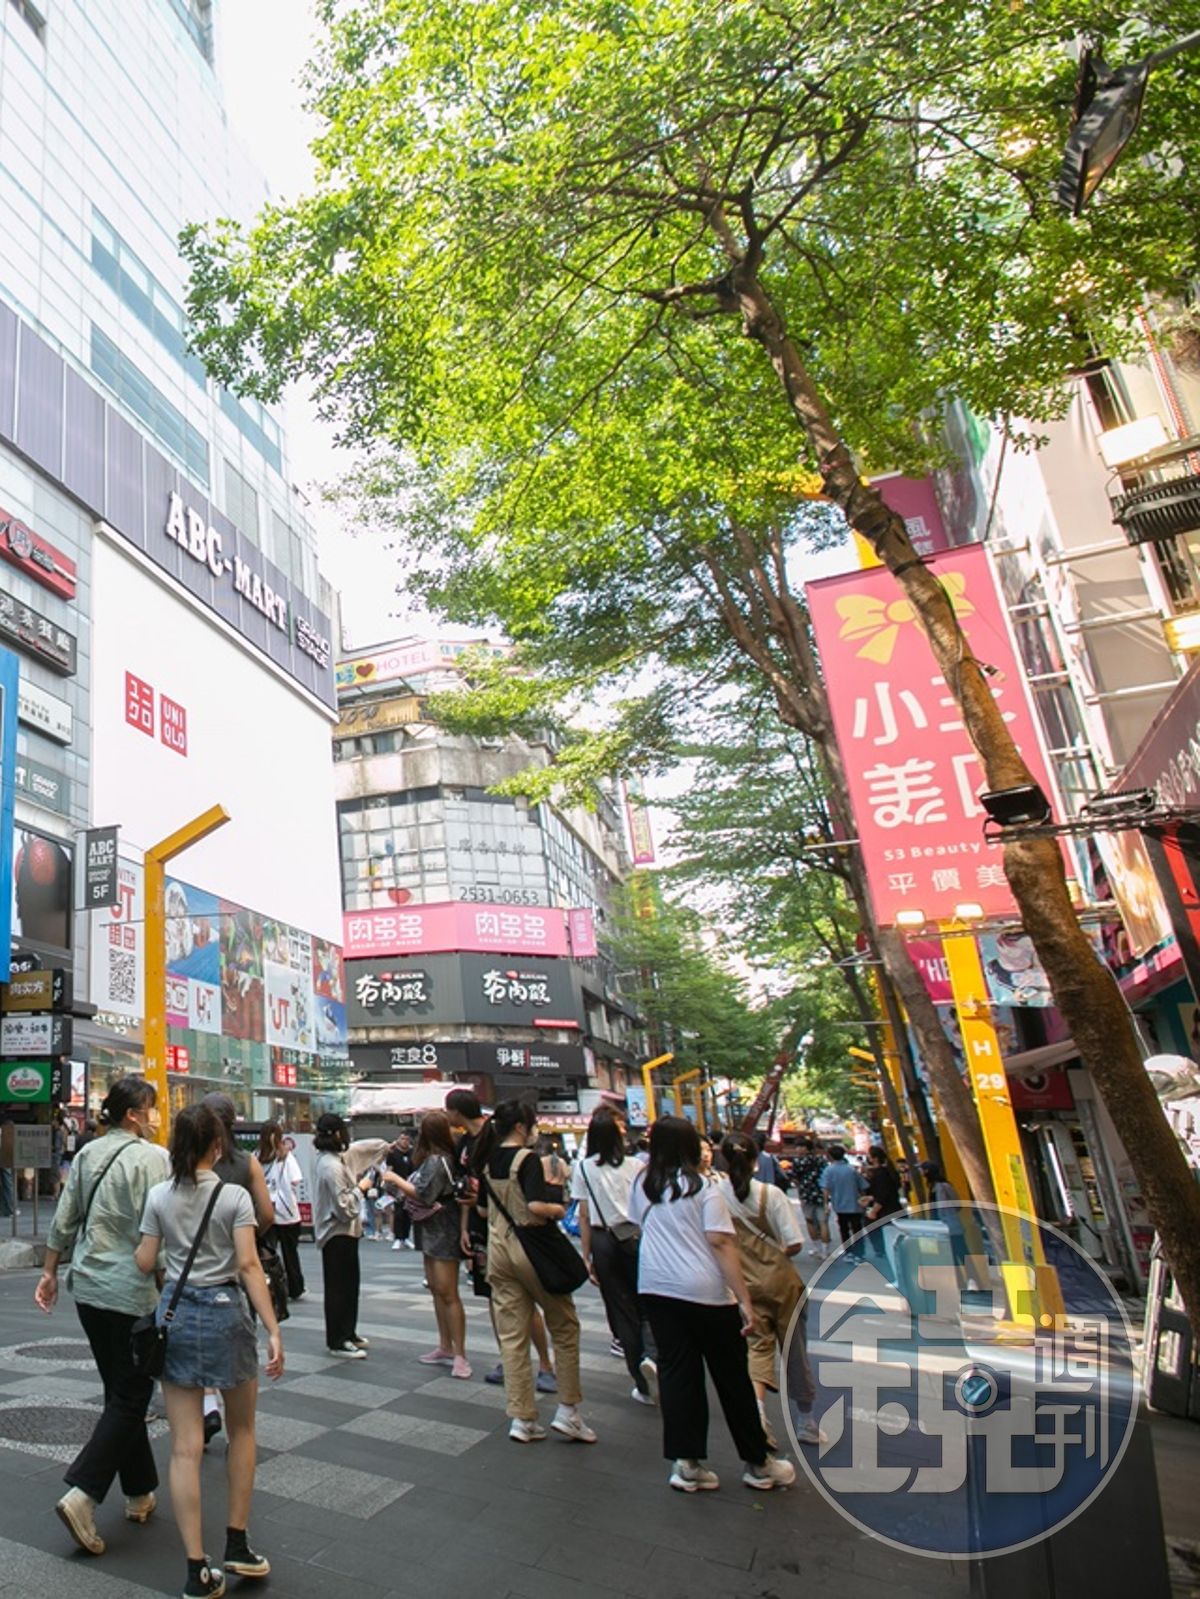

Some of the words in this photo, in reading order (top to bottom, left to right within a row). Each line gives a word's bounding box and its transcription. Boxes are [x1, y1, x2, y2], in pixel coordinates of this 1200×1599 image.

[377, 651, 432, 673] HOTEL
[89, 840, 114, 856] ABC
[911, 842, 981, 858] Beauty
[93, 884, 110, 899] 5F
[460, 886, 540, 905] 2531-0653
[349, 914, 424, 942] 肉多多
[476, 911, 546, 940] 肉多多
[391, 1044, 438, 1065] 定食8
[972, 1040, 992, 1056] H
[976, 1072, 1007, 1091] 29
